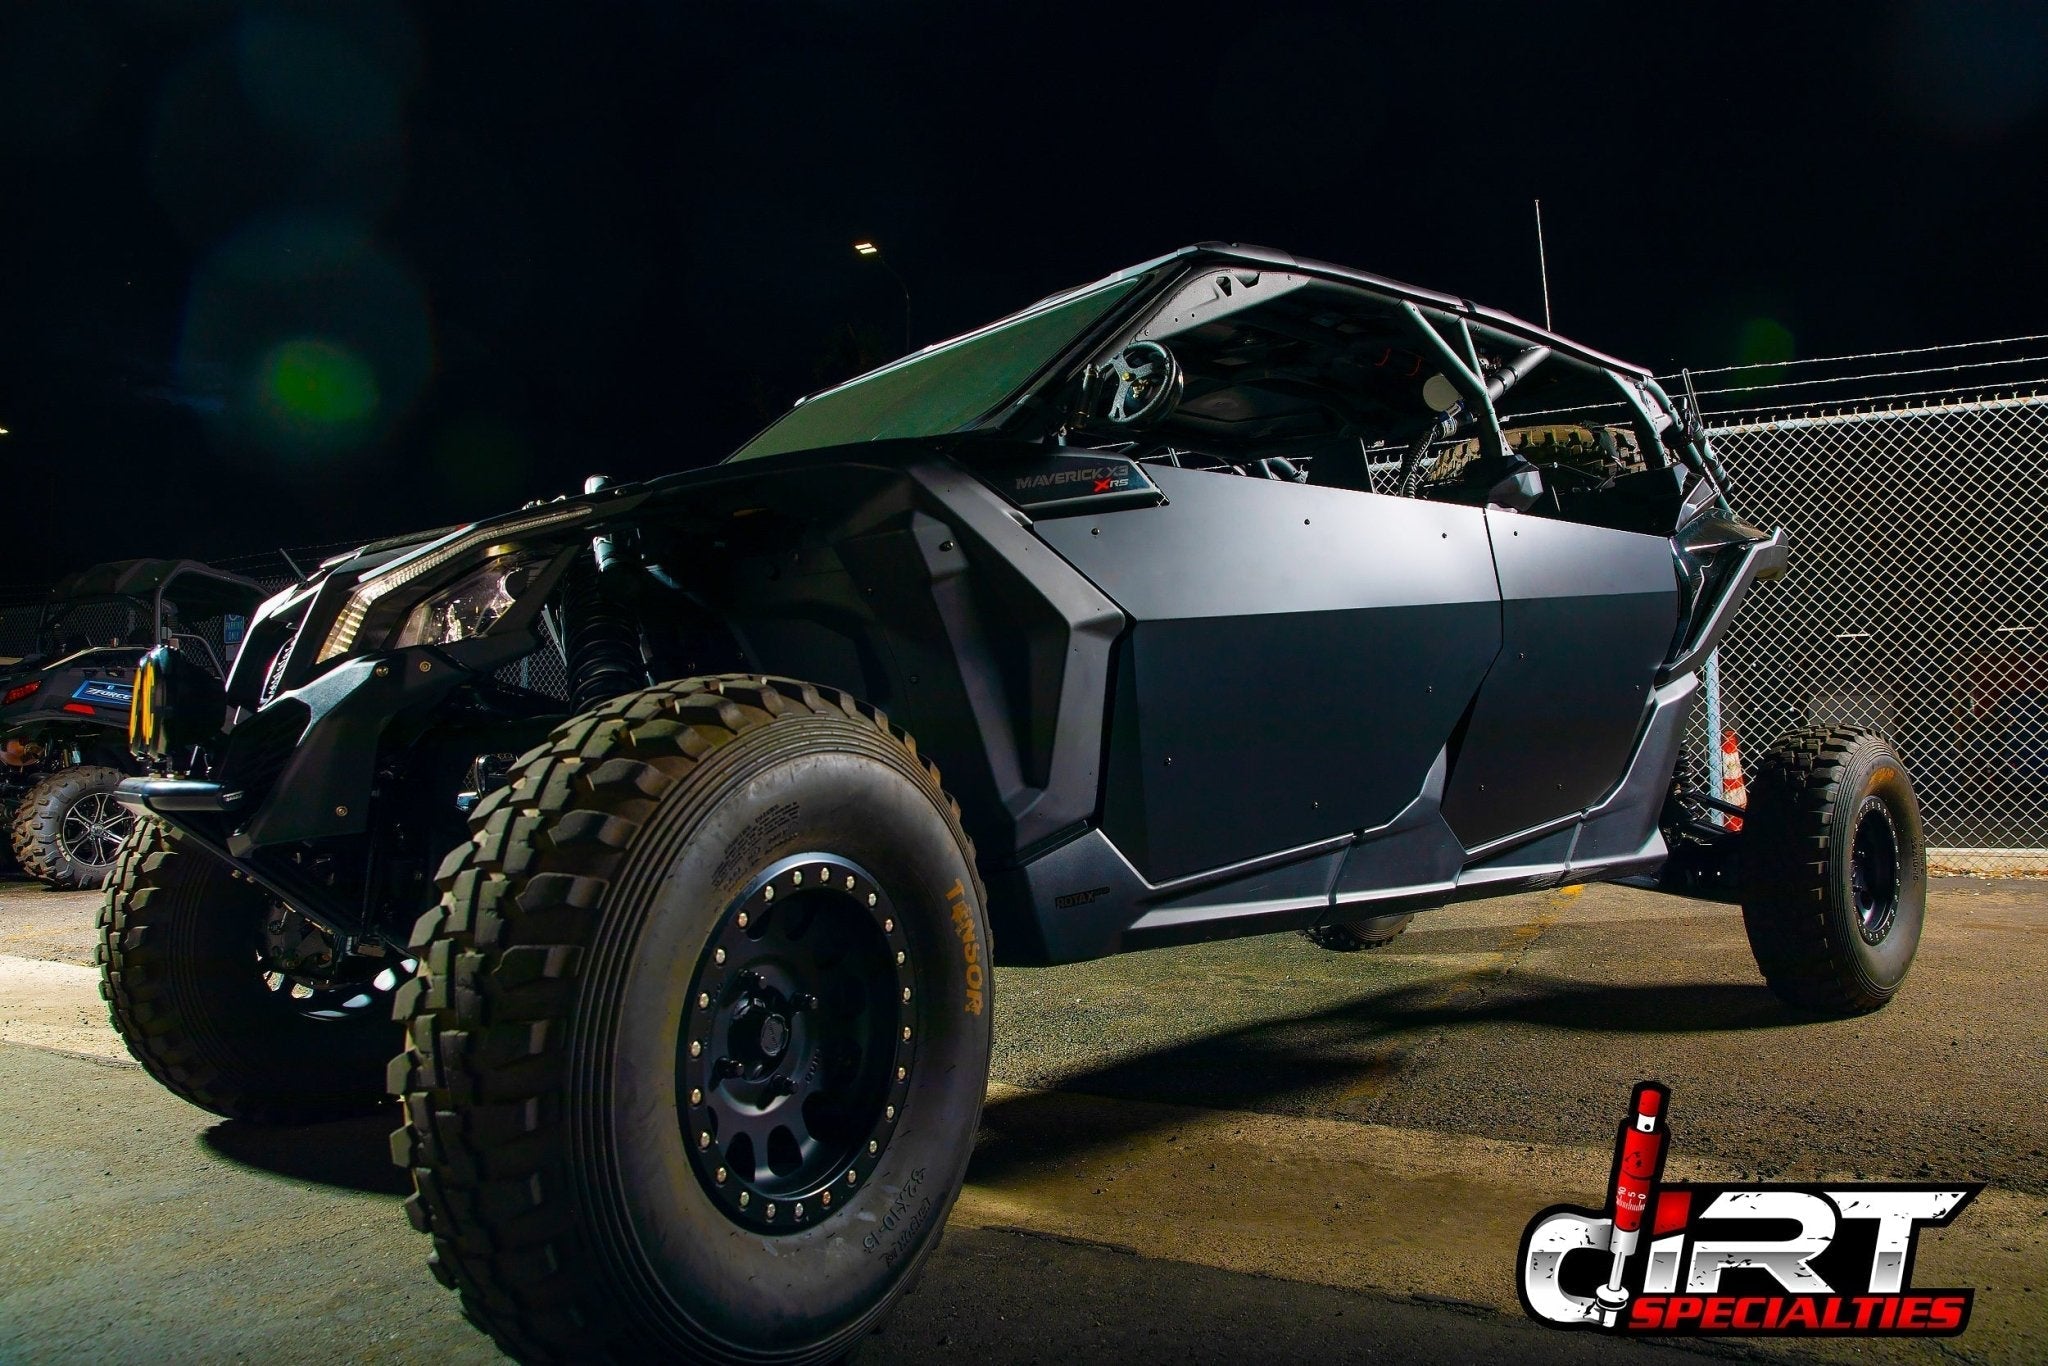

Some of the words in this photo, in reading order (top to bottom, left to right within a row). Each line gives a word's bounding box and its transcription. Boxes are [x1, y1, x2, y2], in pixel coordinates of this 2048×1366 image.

[1016, 467, 1103, 489] MAVERICK
[1107, 464, 1129, 478] X3
[944, 878, 984, 1016] TENSOR
